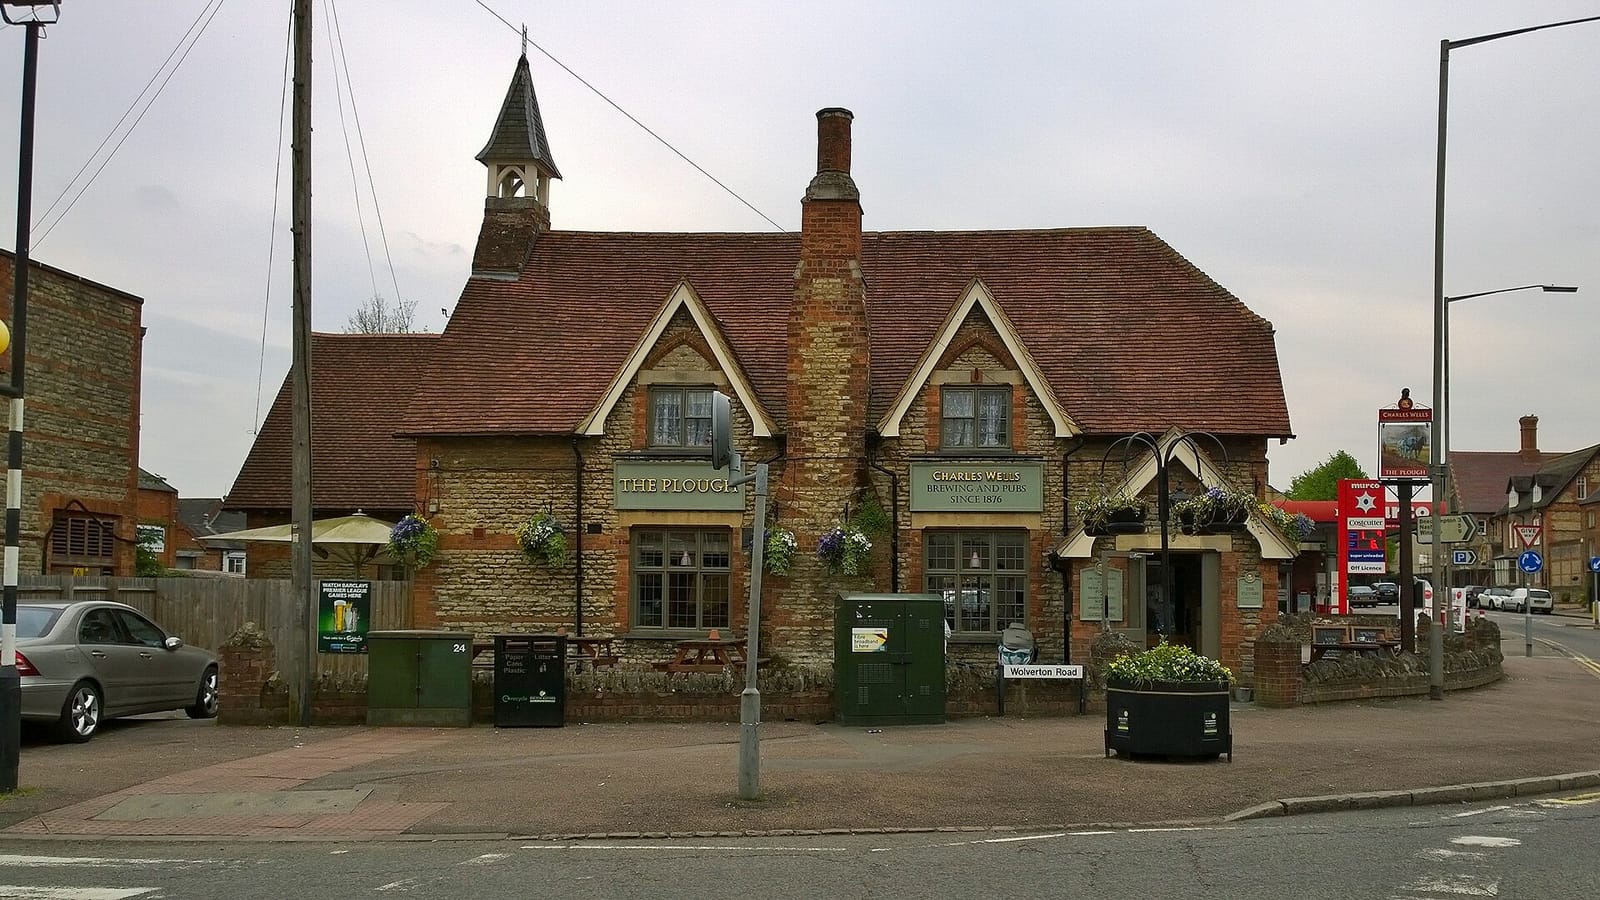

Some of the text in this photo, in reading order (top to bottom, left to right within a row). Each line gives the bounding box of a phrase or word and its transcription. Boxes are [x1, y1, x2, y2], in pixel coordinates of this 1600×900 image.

[932, 470, 1021, 482] CHARLES WELLS
[619, 478, 658, 493] THE
[927, 484, 1027, 493] BREWING AND PUBS
[950, 495, 1003, 504] SINCE 1876
[1349, 520, 1383, 528] Costcutter
[453, 643, 466, 653] 24
[1010, 667, 1078, 676] Wolverton Road
